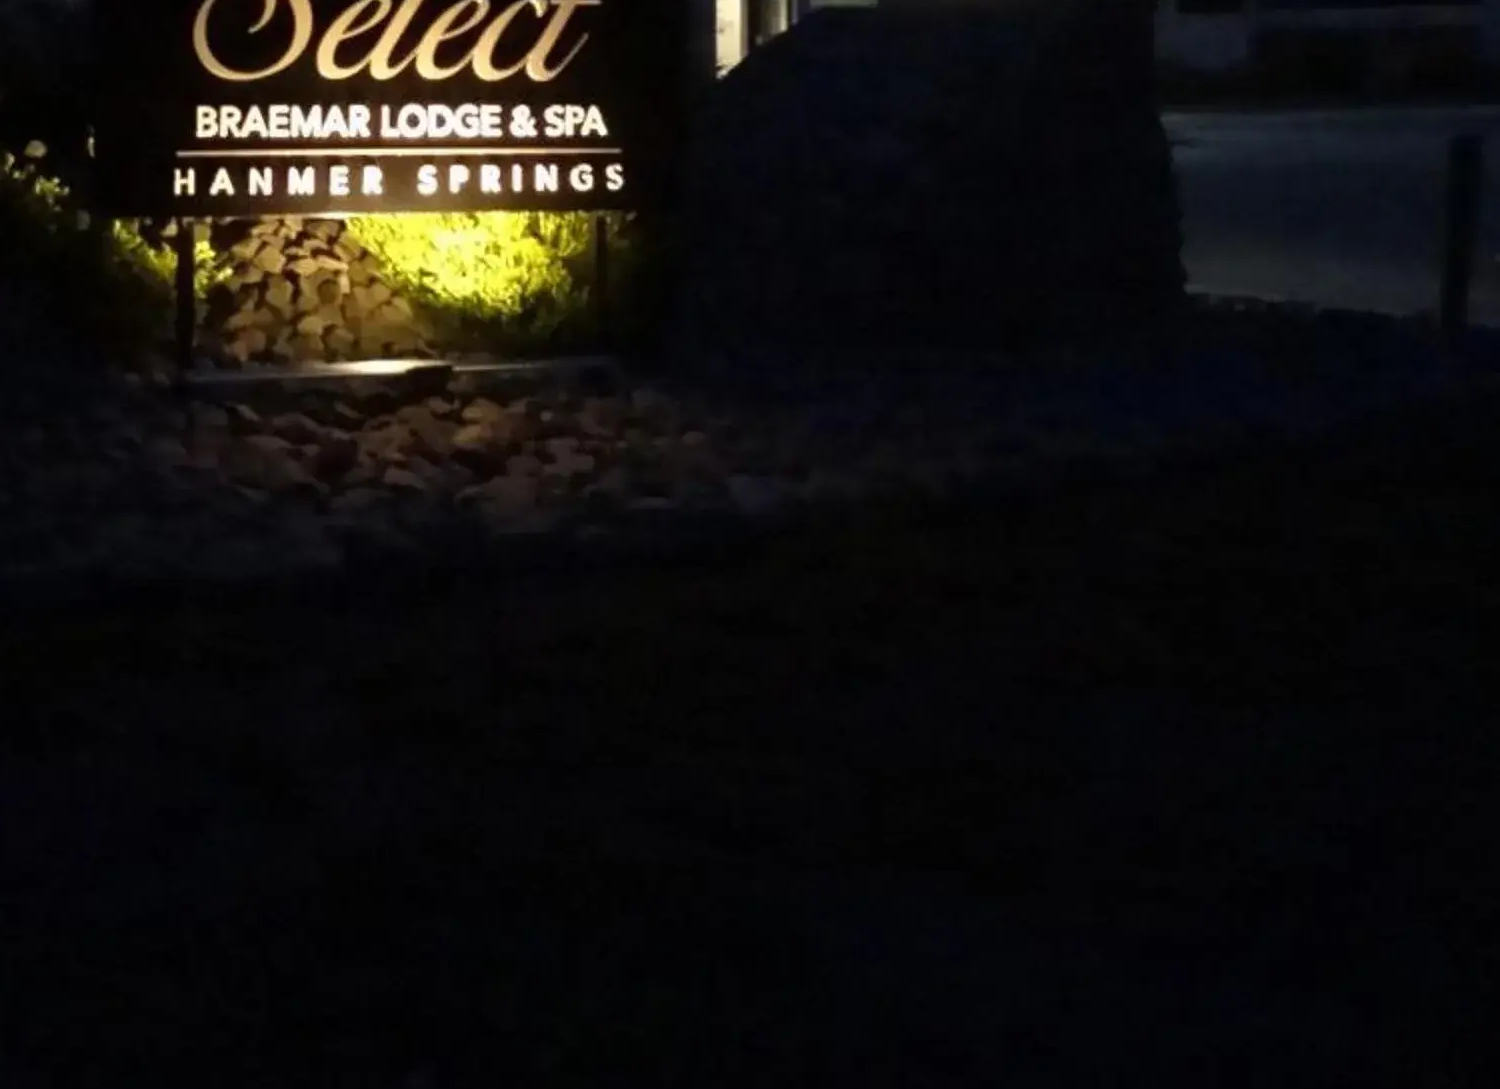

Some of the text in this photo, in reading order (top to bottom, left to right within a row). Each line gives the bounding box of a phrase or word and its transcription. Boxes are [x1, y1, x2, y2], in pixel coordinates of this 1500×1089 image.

[195, 103, 609, 140] BRAEMAR LODGE & SPA
[173, 163, 625, 198] HANMER SPRINGS
